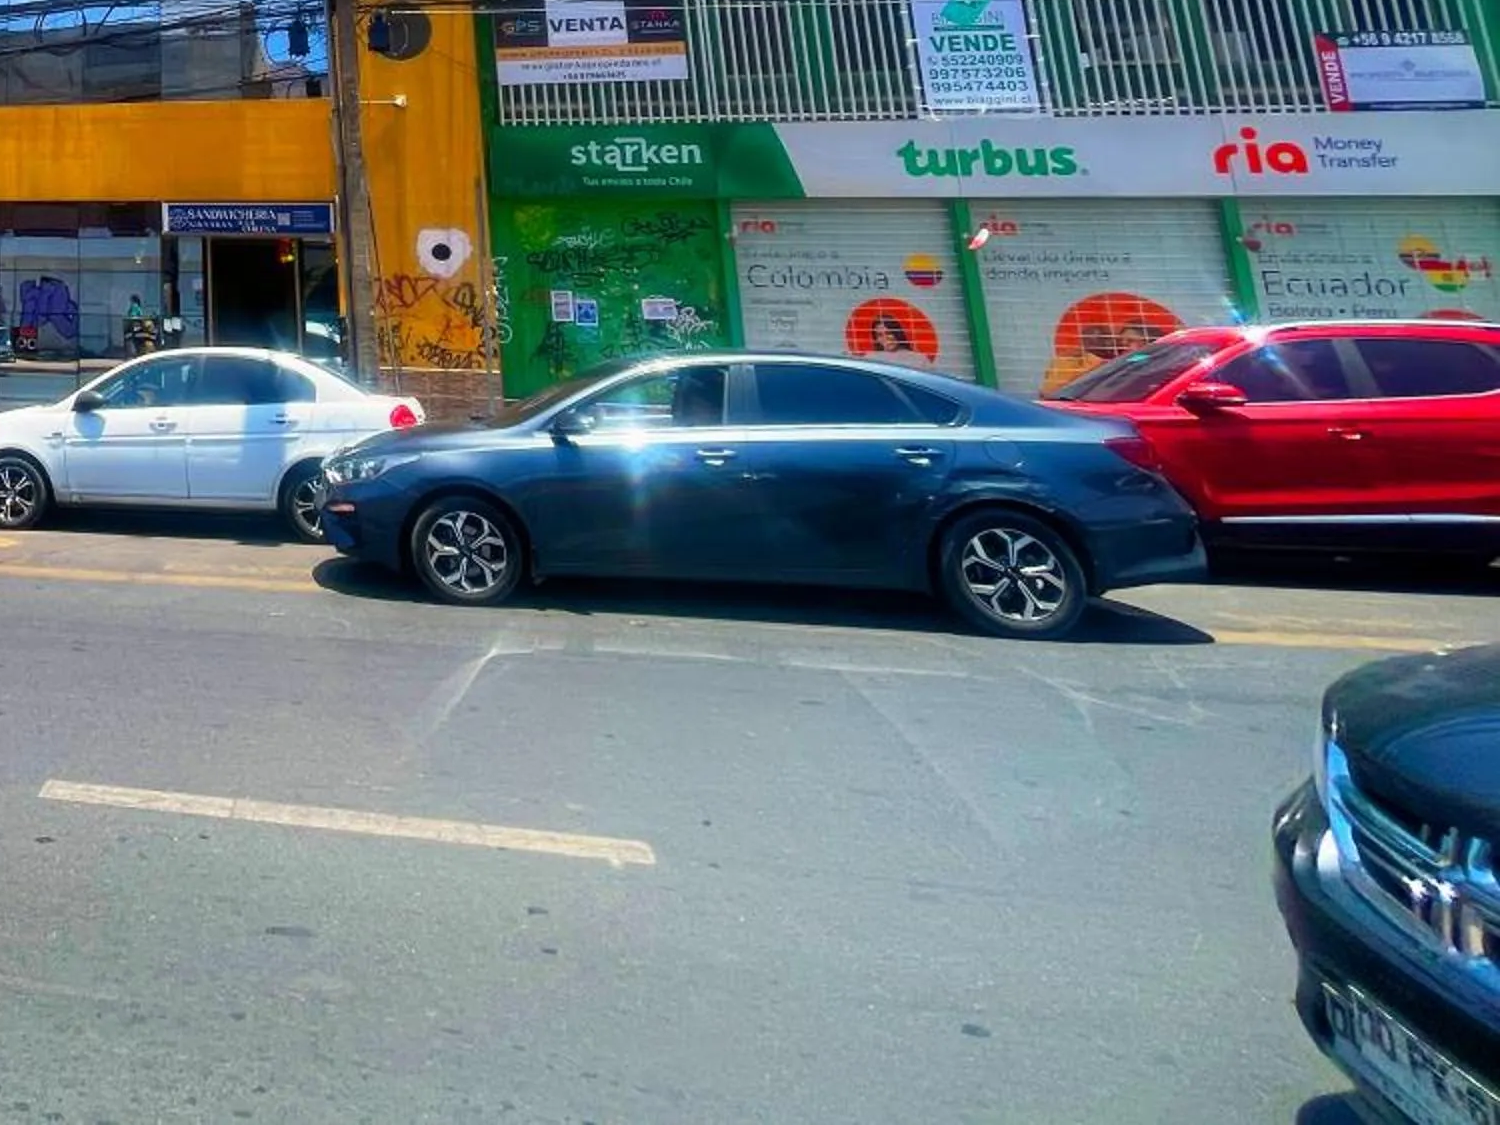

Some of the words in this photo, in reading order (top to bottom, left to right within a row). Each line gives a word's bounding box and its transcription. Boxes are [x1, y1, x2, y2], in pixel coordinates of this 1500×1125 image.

[550, 16, 625, 33] VENTA
[929, 33, 1017, 53] VENDE
[940, 54, 1024, 66] 552240909
[929, 66, 1027, 80] 997573206
[1321, 50, 1344, 105] VENDE
[931, 80, 1029, 92] 995474403
[1213, 126, 1309, 174] ria
[1314, 135, 1383, 153] Money
[571, 137, 703, 172] starken
[896, 139, 1077, 176] turbus
[1317, 152, 1399, 170] Transfer
[747, 264, 890, 290] Colombia
[1261, 270, 1412, 297] Ecuador
